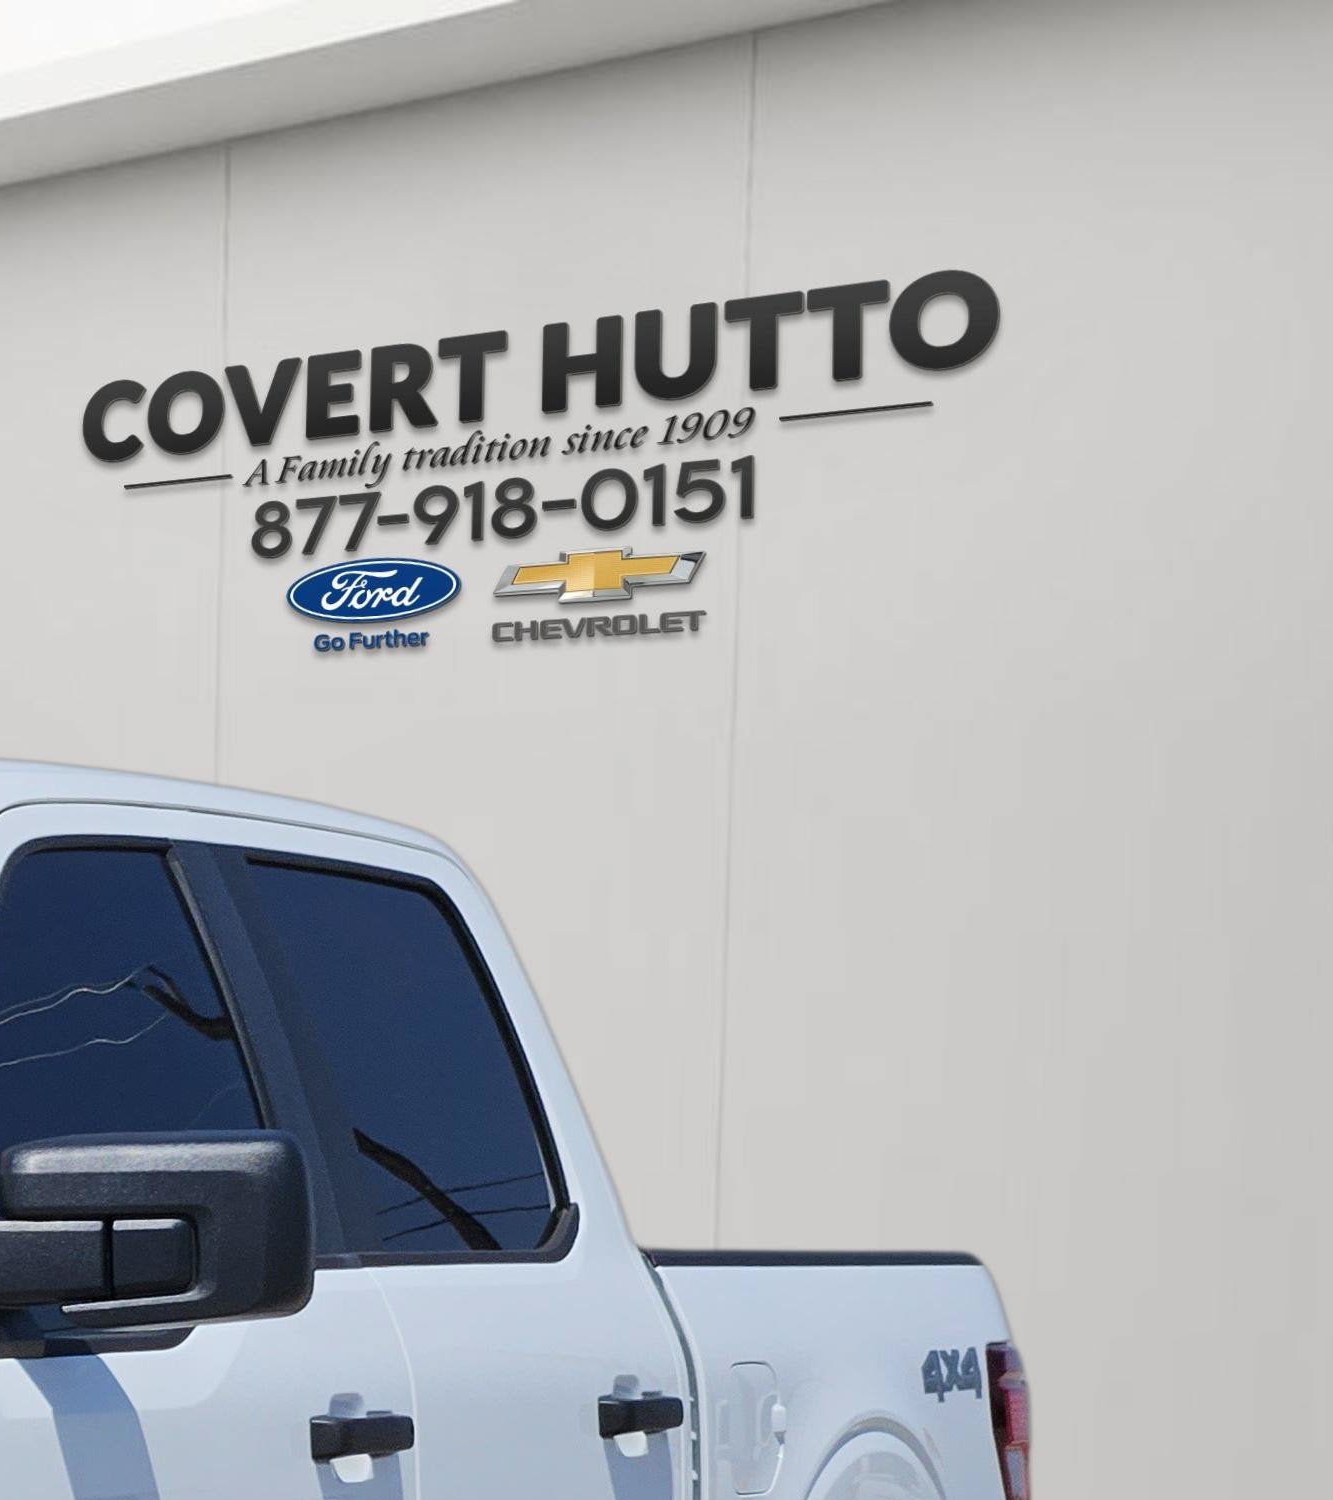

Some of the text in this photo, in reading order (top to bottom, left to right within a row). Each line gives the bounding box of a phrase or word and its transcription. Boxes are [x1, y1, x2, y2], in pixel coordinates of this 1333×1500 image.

[82, 269, 1001, 464] COVERT HUTTO
[242, 407, 756, 489] A Family tradition since 1909
[250, 455, 755, 560] 877-918-0151
[321, 570, 424, 610] Ford
[313, 628, 430, 653] Go Further
[491, 610, 707, 644] CHEVROLET
